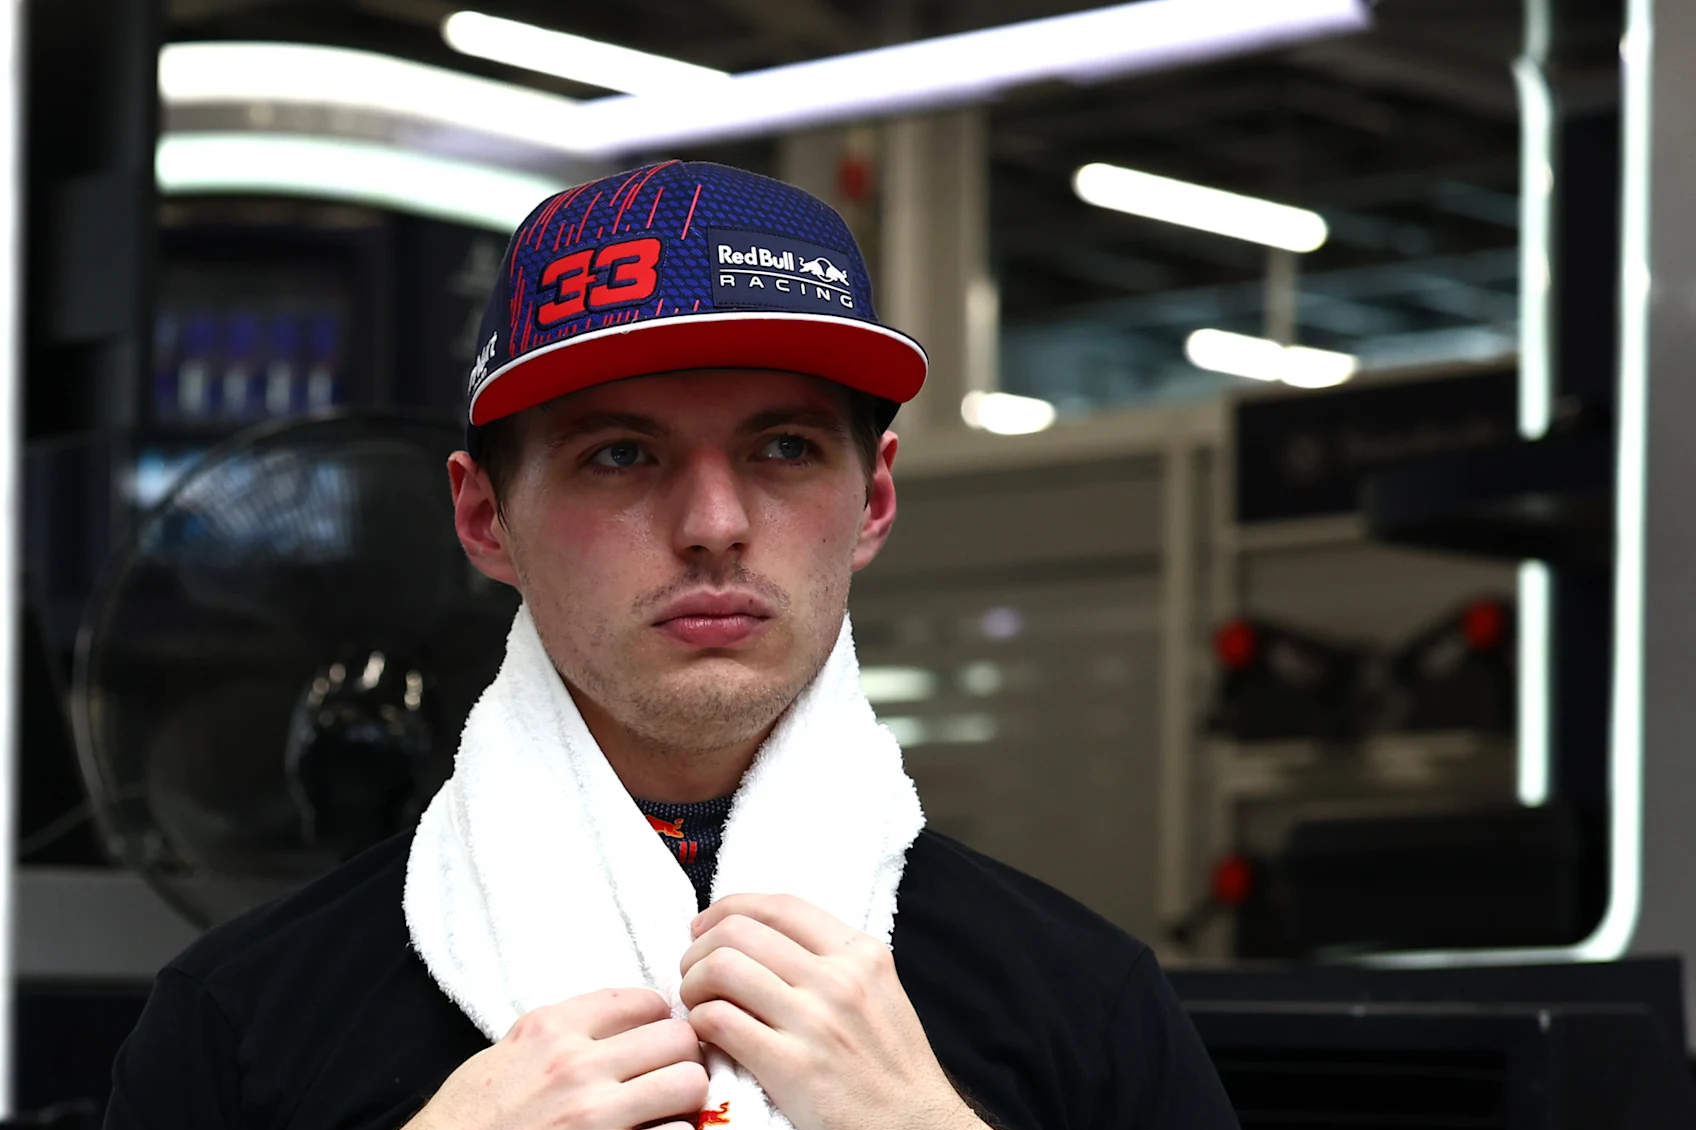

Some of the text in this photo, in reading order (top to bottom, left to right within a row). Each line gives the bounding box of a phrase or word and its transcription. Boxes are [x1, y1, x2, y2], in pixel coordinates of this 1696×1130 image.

[717, 244, 795, 272] Red Bull
[536, 237, 662, 326] 33
[719, 274, 854, 309] RACING
